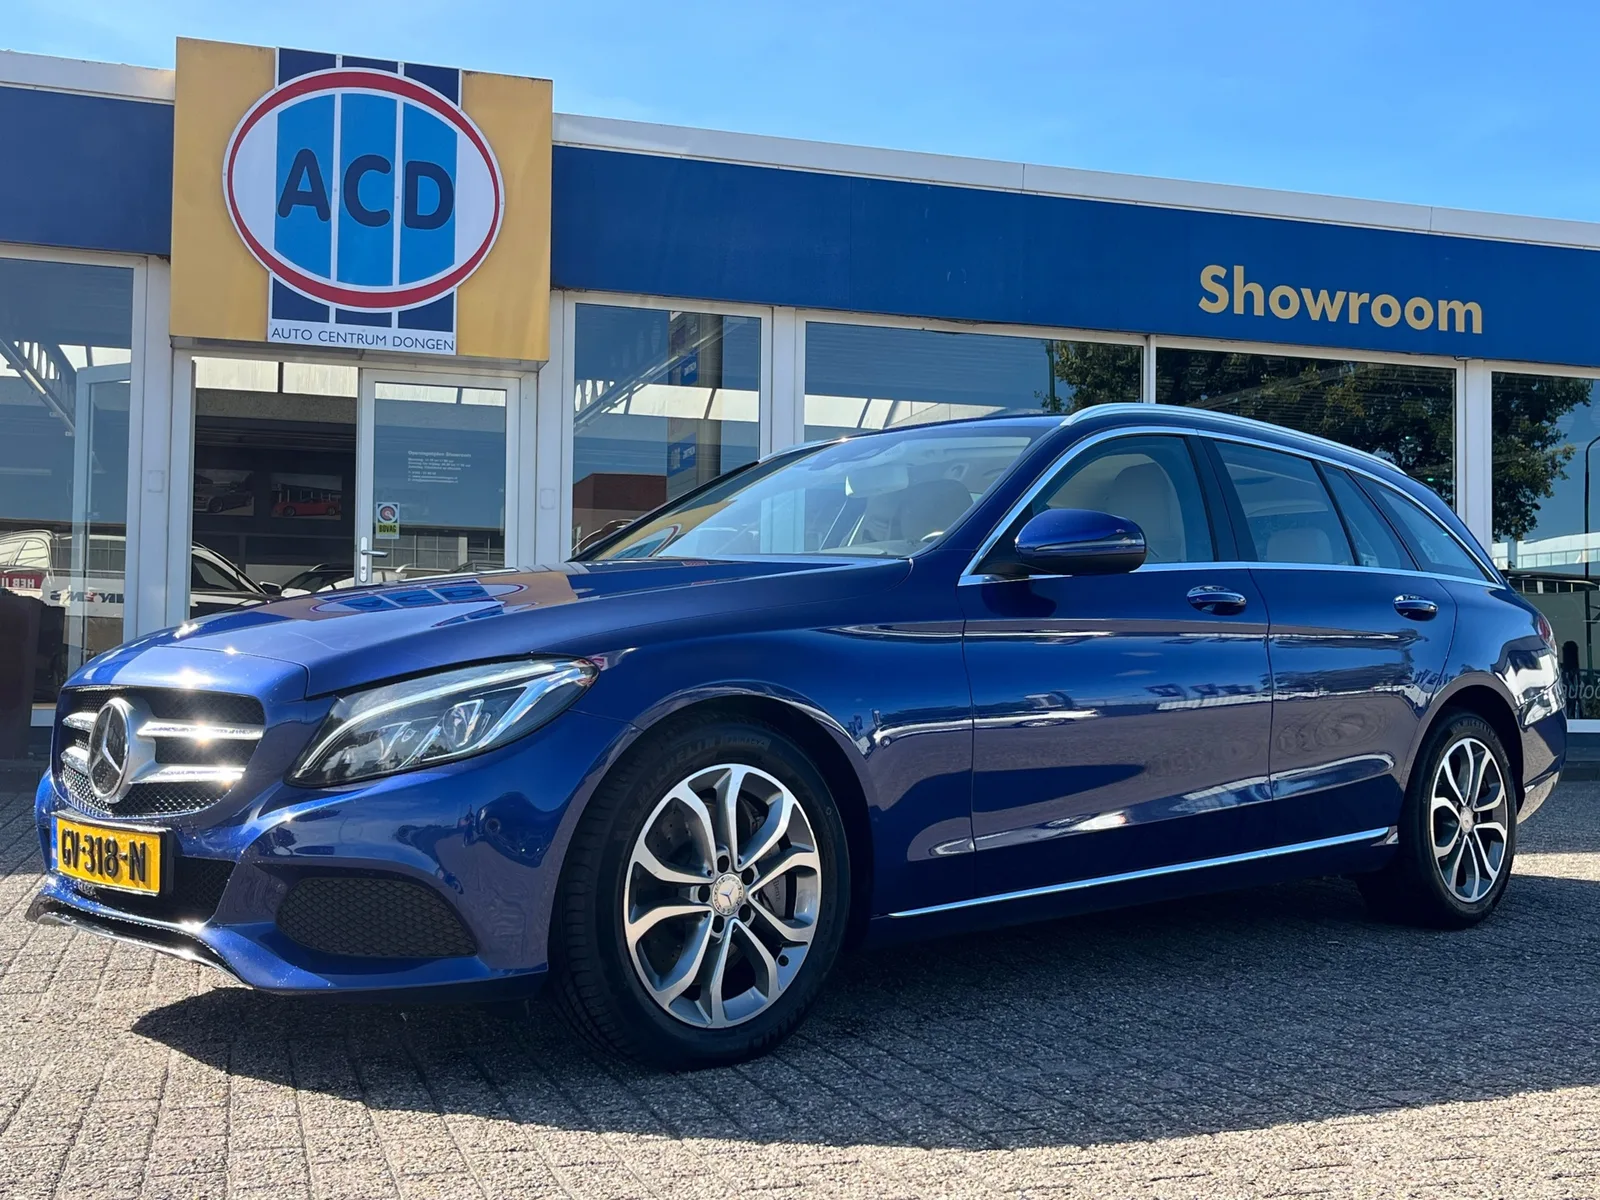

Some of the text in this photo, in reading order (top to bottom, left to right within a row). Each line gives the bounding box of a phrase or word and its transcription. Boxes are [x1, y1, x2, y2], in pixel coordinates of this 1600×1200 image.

[277, 148, 455, 230] ACD
[1198, 264, 1483, 334] Showroom
[271, 327, 455, 352] AUTO CENTRUM DONGEN
[379, 525, 397, 533] BOVAG
[61, 828, 146, 882] GV-318-N
